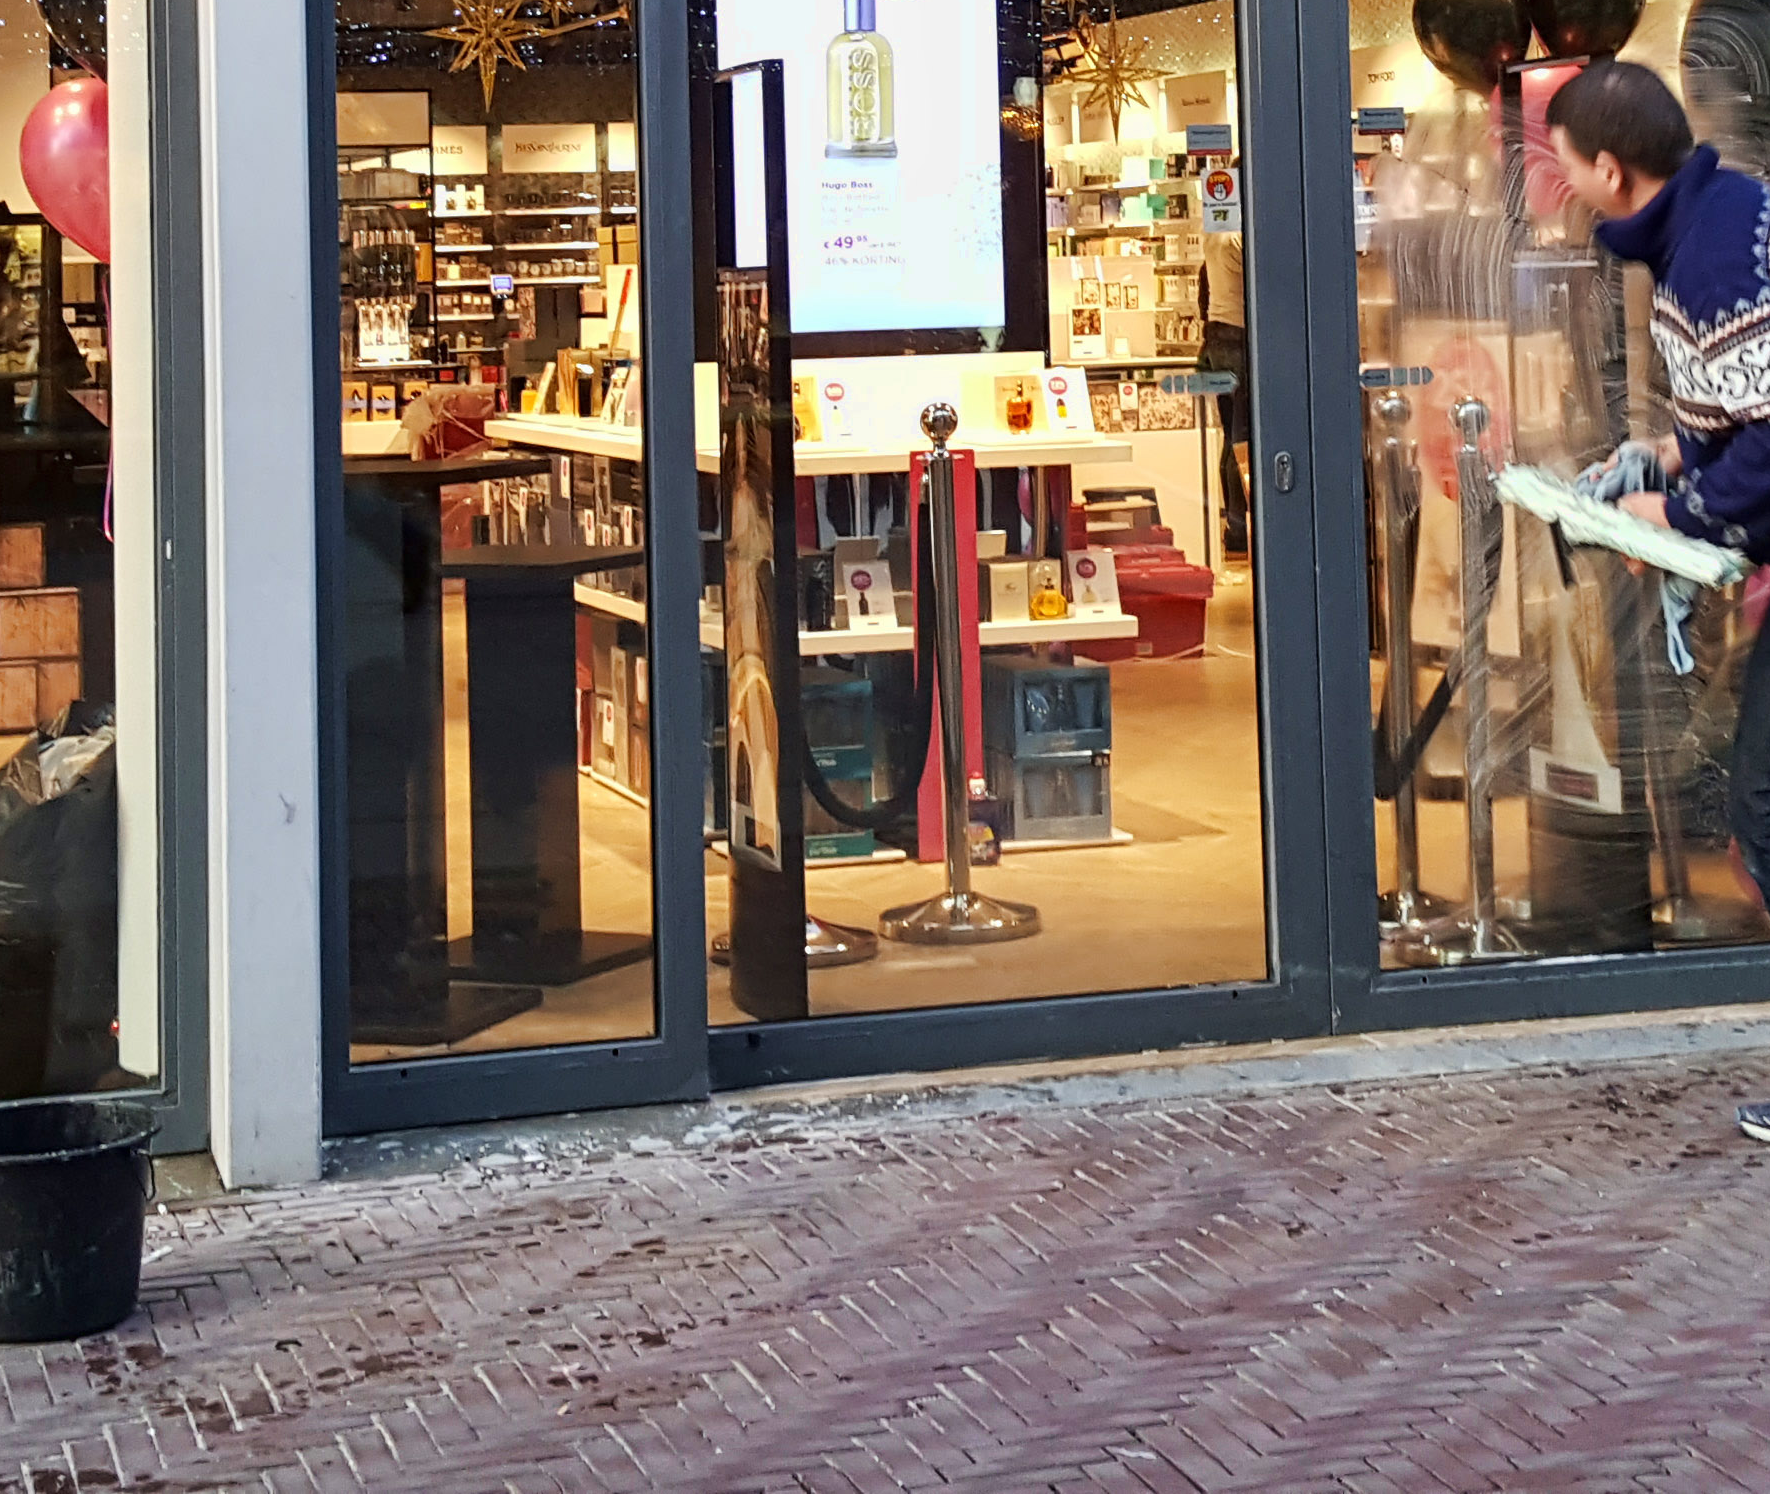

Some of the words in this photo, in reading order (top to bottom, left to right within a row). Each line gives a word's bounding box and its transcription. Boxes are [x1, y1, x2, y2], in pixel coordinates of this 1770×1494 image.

[821, 181, 848, 190] Hugo
[850, 180, 873, 189] Boss
[833, 235, 854, 249] 49
[851, 254, 907, 266] KORTING
